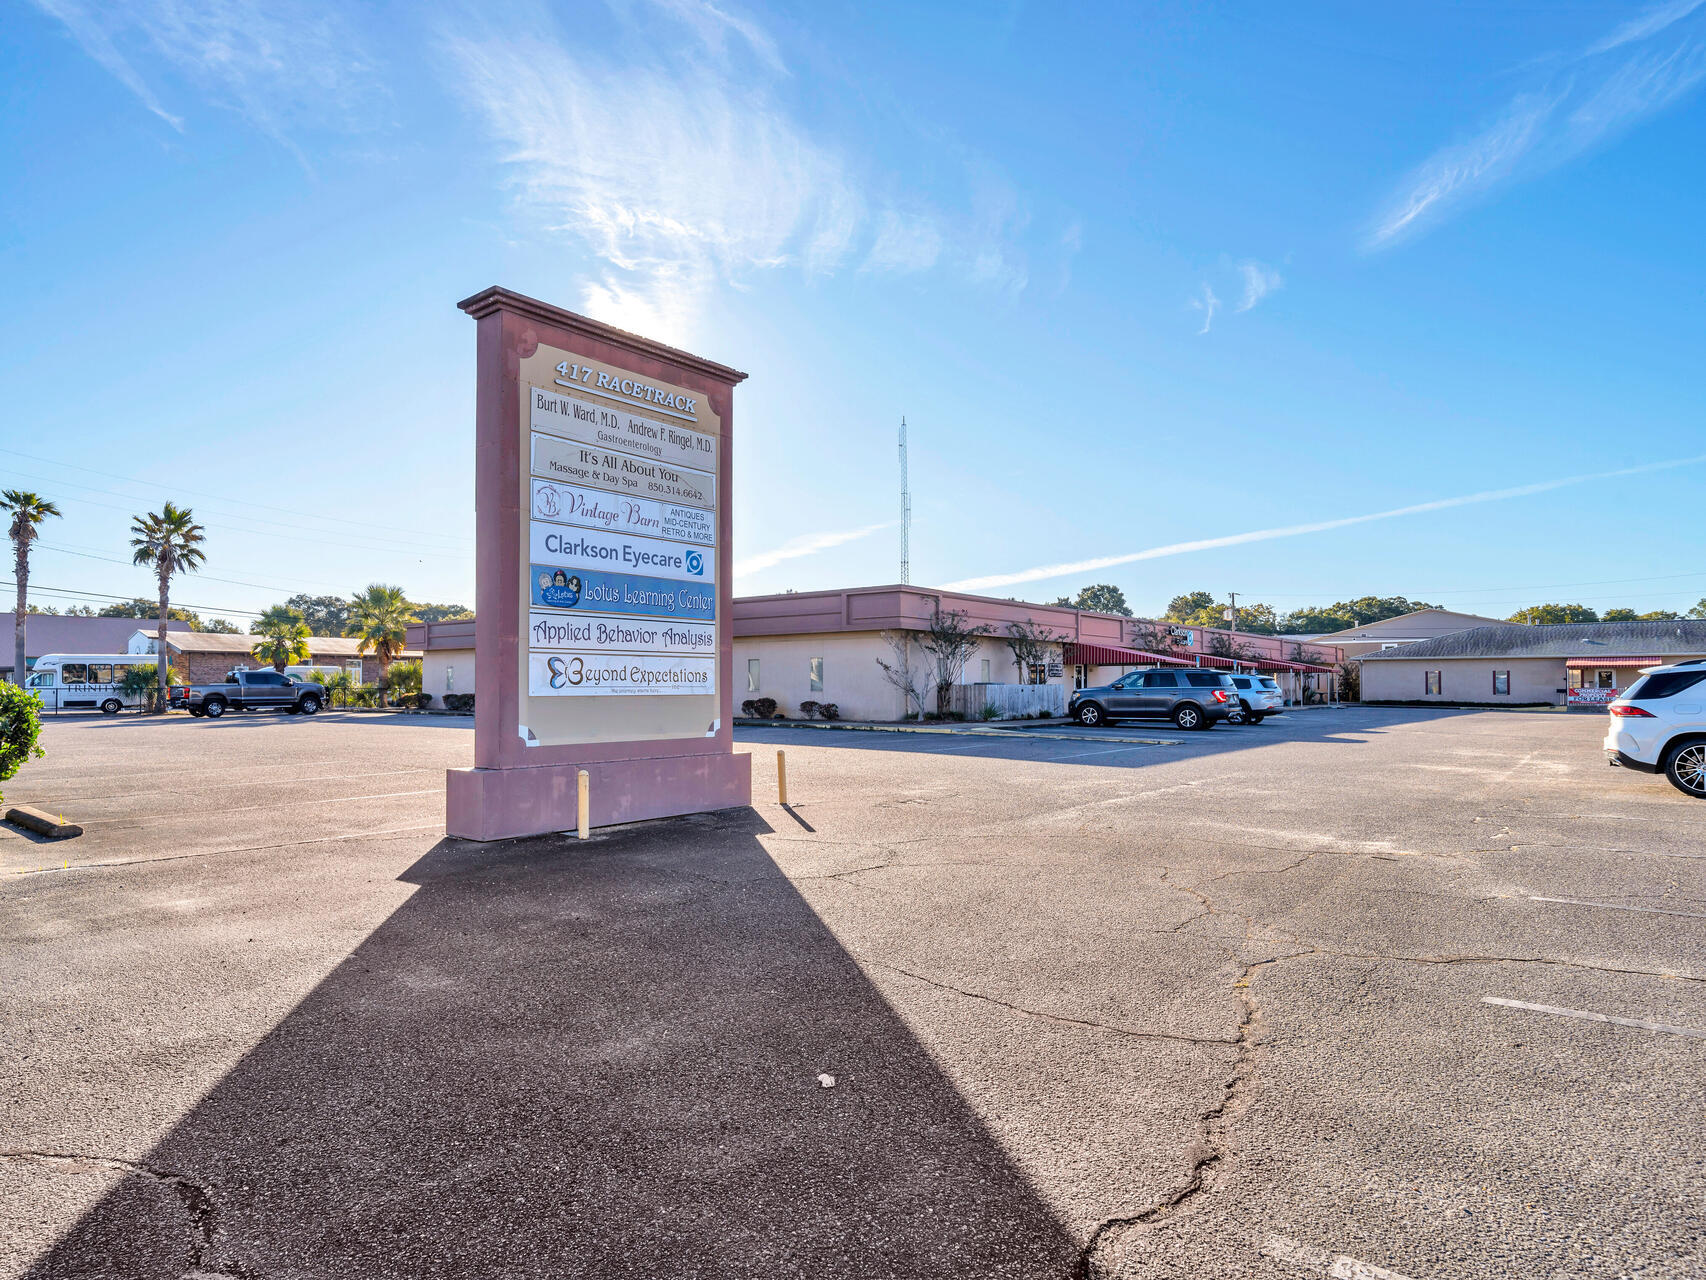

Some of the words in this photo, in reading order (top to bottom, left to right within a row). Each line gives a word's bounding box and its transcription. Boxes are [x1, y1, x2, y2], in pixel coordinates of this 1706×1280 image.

[556, 360, 593, 382] 417
[597, 371, 696, 414] RACETRACK
[537, 394, 557, 413] Burt
[561, 401, 570, 416] W.
[573, 404, 598, 425] Ward,
[600, 412, 619, 429] M.D.
[597, 431, 662, 456] Gastroenterology
[627, 419, 657, 439] Andrew
[660, 428, 666, 441] F.
[669, 430, 694, 449] Ringel,
[696, 438, 713, 453] M.D.
[549, 461, 589, 479] Massage
[592, 471, 600, 479] &
[603, 473, 619, 484] Day
[622, 476, 638, 488] Spa
[648, 482, 702, 500] 850.314.6642
[580, 450, 598, 465] It's
[602, 456, 617, 469] All
[621, 460, 655, 477] About
[658, 468, 678, 482] You
[562, 490, 619, 525] Vintage
[620, 501, 659, 527] Barn
[670, 509, 704, 521] ANTIQUES
[662, 527, 686, 537] RETRO
[693, 531, 713, 541] MORE
[664, 518, 710, 532] MID-CENTURY
[545, 534, 618, 560] Clarkson
[623, 545, 682, 568] Eyecare
[585, 580, 619, 602] Lotus
[624, 584, 675, 611] Learning
[678, 589, 713, 610] Center
[533, 621, 591, 643] Applied
[597, 624, 657, 644] Behavior
[662, 628, 713, 649] Analysis
[630, 667, 707, 686] Expectations
